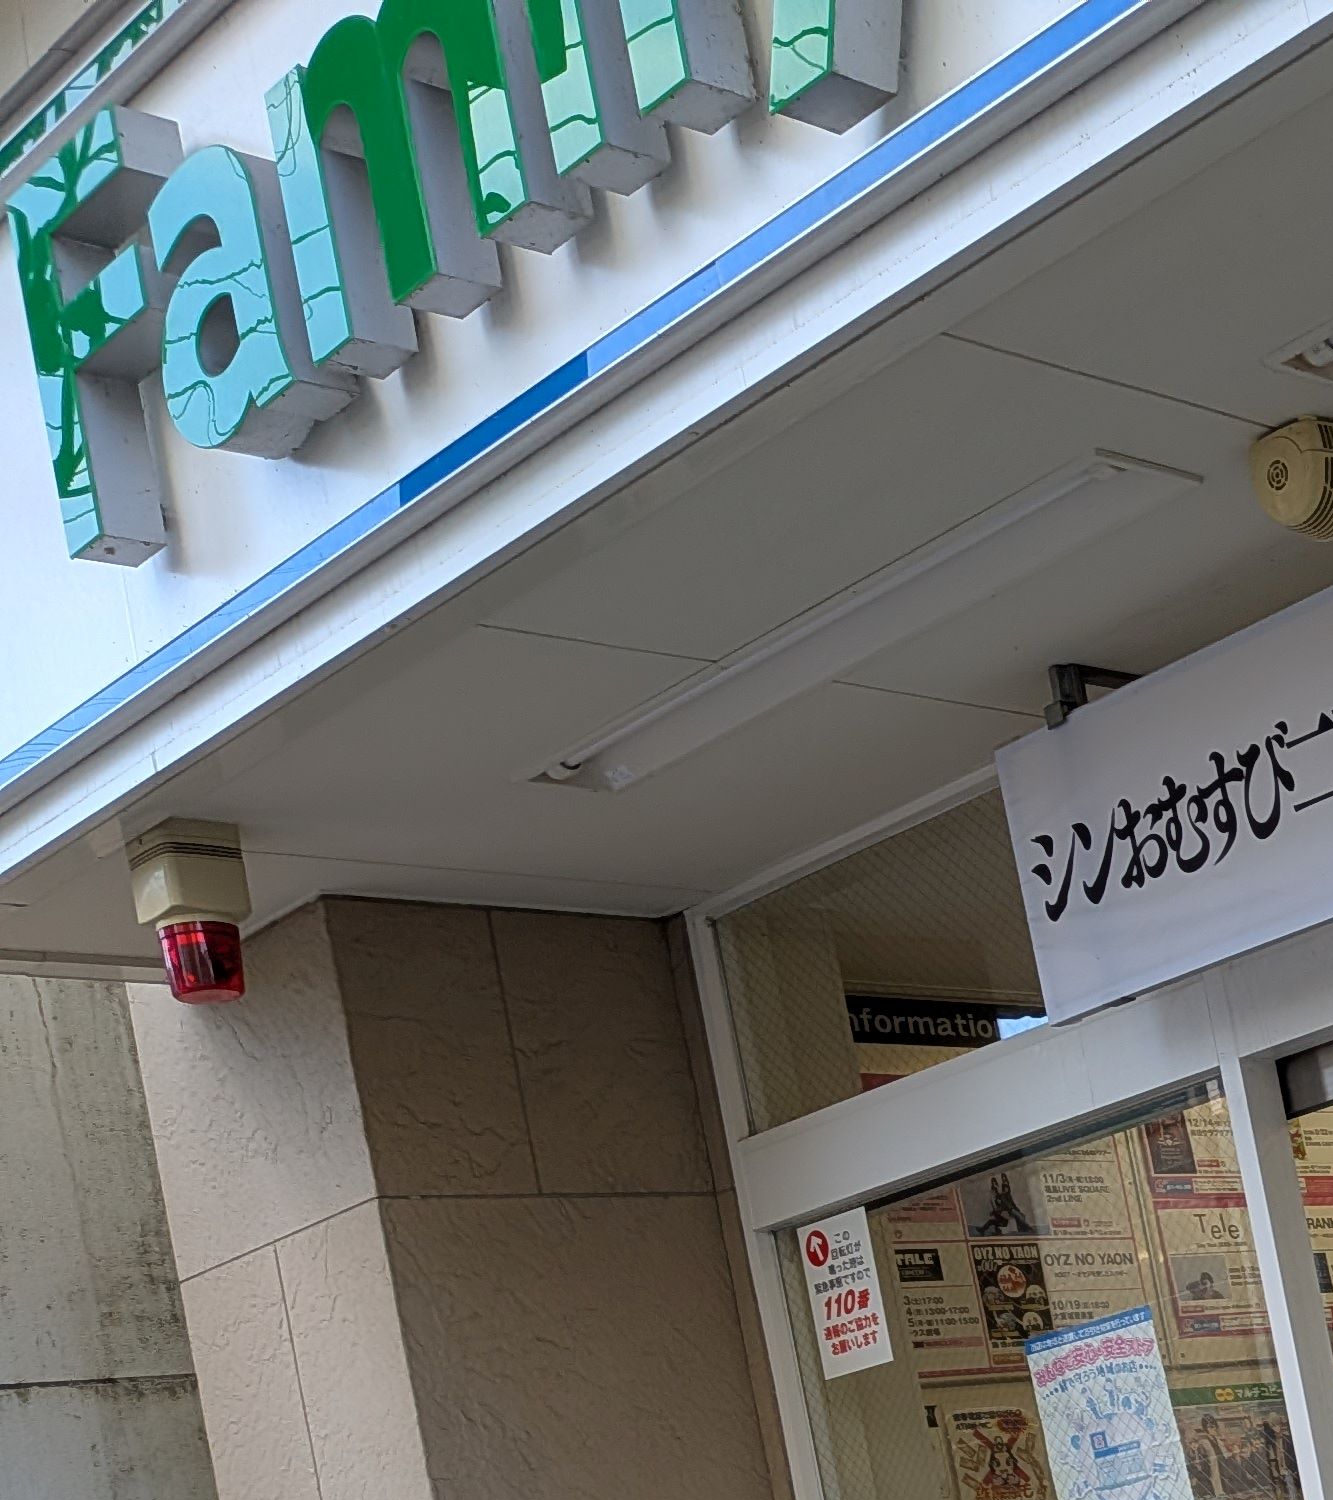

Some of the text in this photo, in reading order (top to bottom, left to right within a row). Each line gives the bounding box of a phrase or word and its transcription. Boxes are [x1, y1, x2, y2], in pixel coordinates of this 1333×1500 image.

[8, 0, 835, 560] Fam
[850, 1007, 1000, 1040] nformatio
[833, 1231, 851, 1244] この
[1193, 1212, 1241, 1240] Tele
[1044, 1252, 1134, 1267] OYZ NO YAON
[824, 1288, 871, 1321] 110番
[831, 1329, 879, 1356] お願いします
